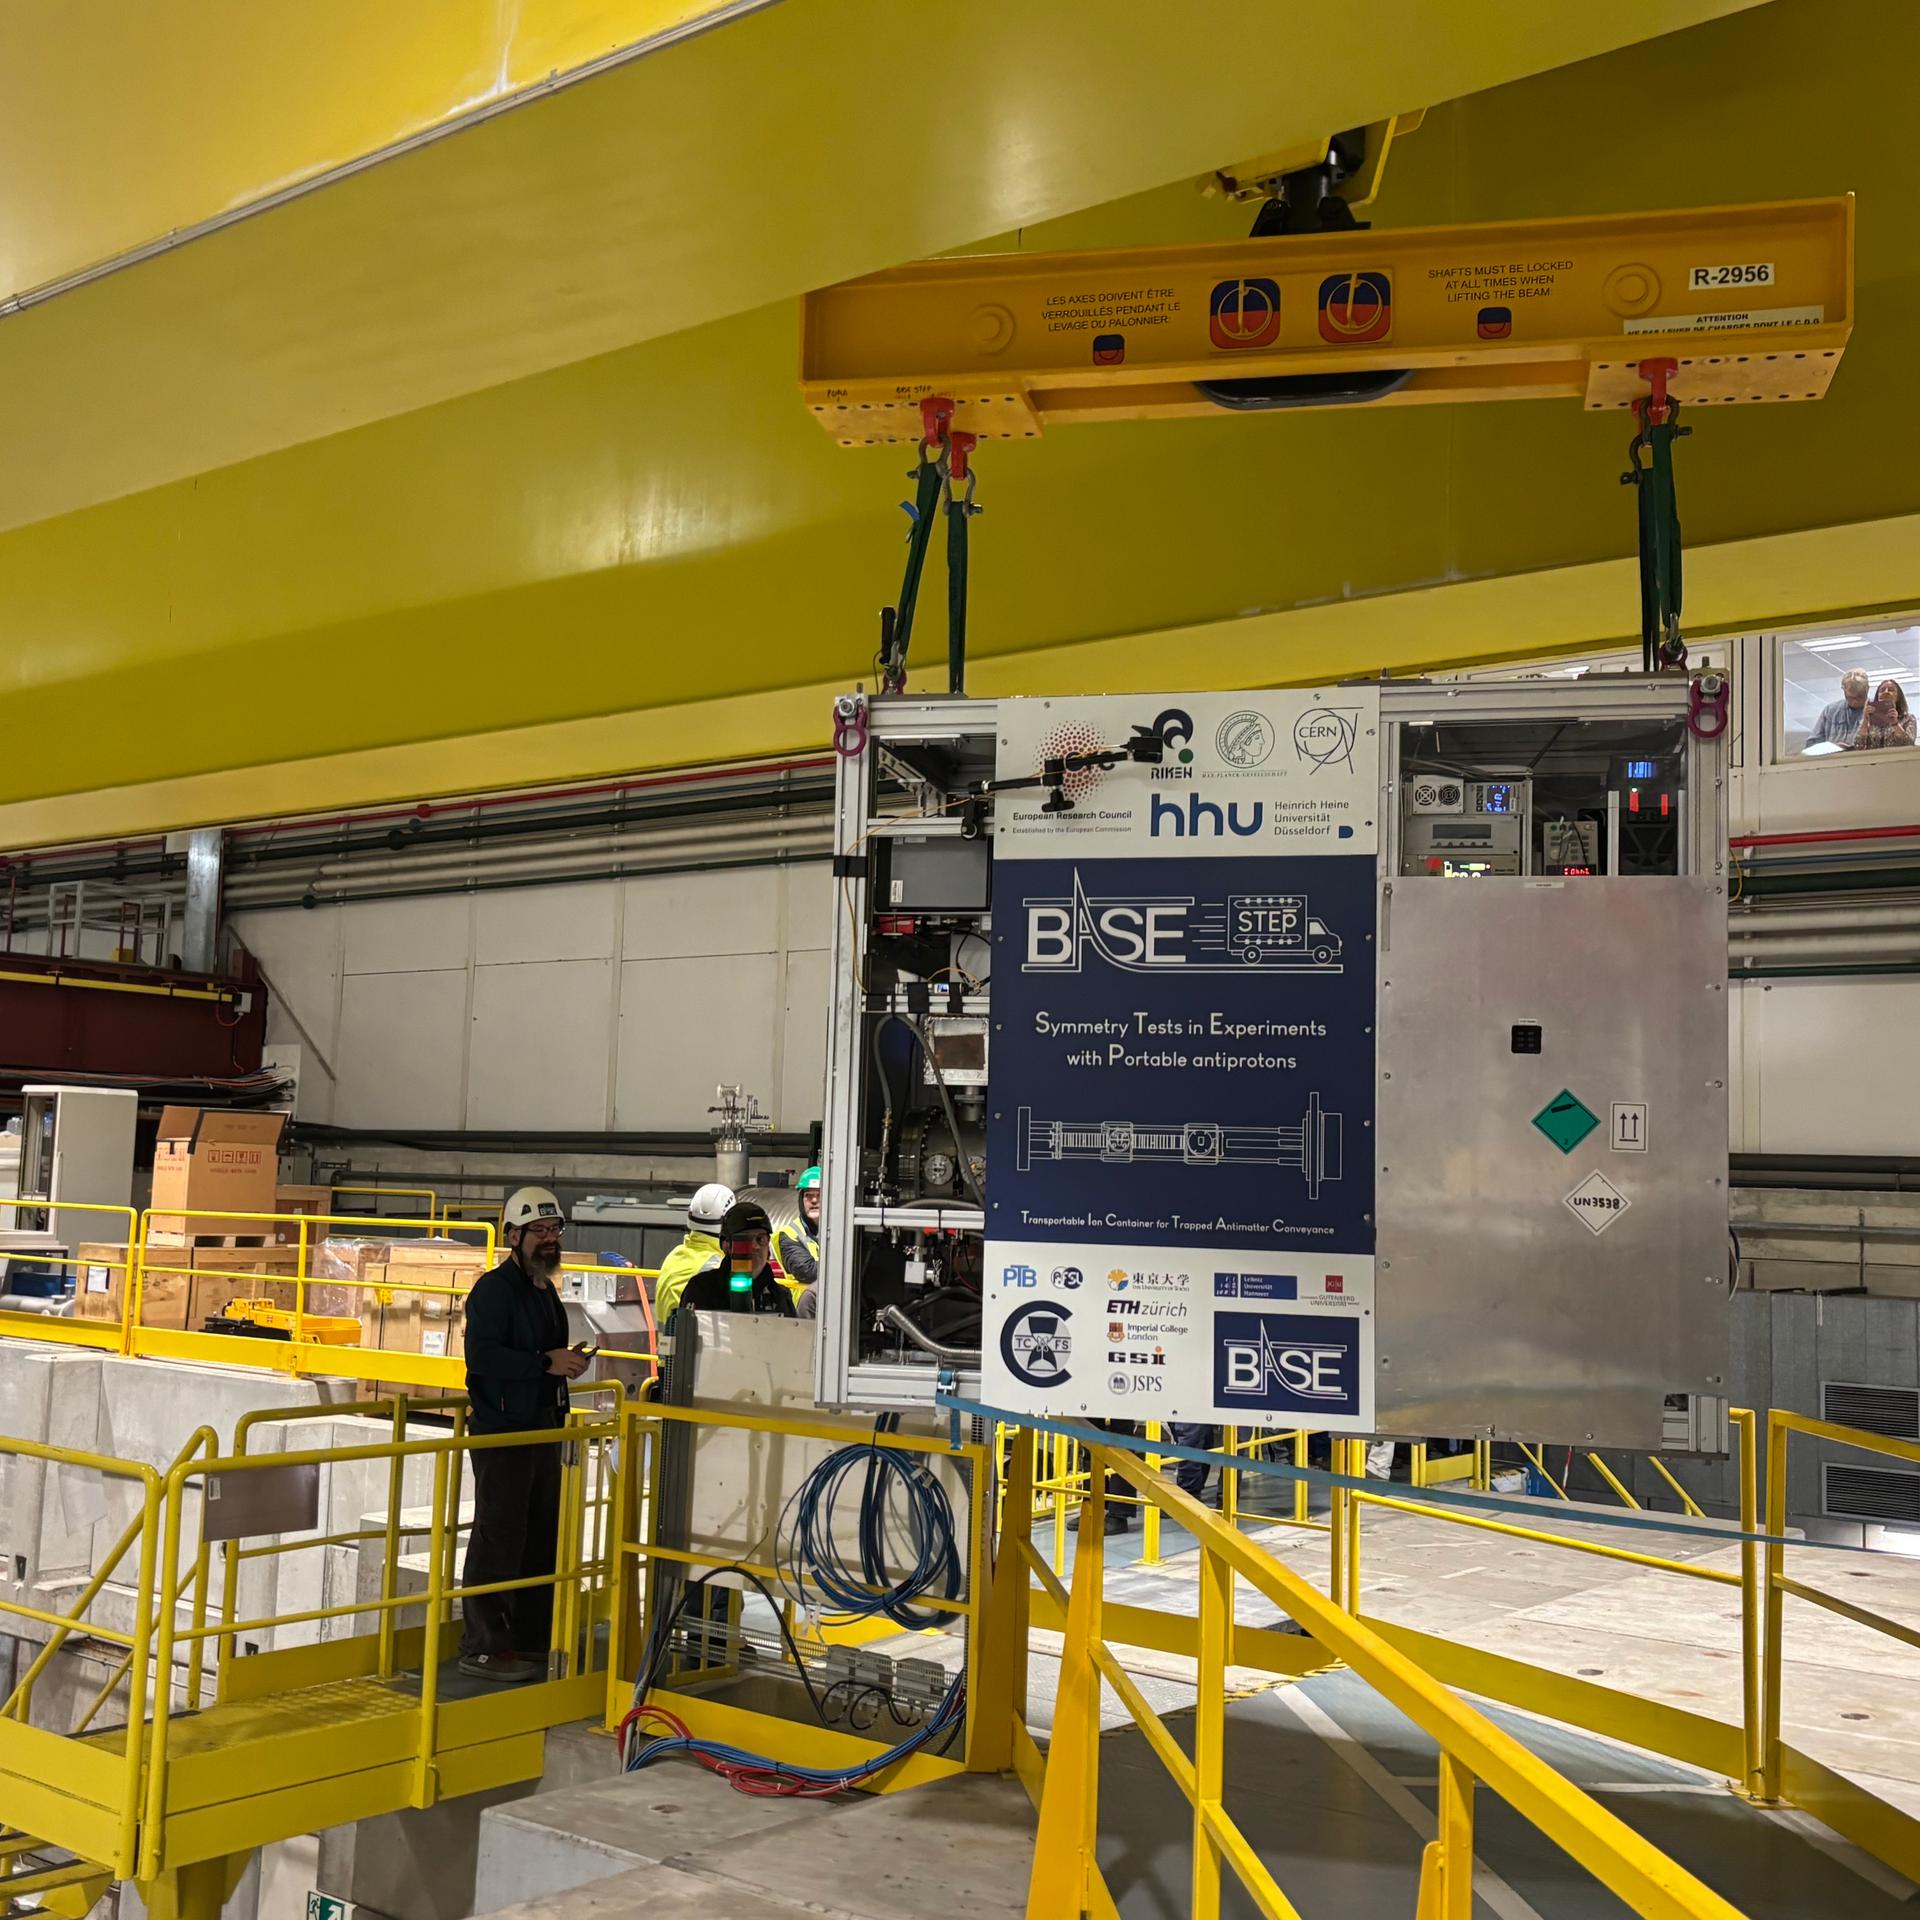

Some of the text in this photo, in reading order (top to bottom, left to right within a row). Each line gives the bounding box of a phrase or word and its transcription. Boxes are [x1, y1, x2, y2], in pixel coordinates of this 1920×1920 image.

[1428, 260, 1574, 279] SHAFTS MUST BE LOCKED
[1694, 265, 1769, 285] R-2956
[1445, 275, 1554, 290] AT ALL TIMES WHEN
[1046, 296, 1066, 306] LES
[1069, 294, 1096, 304] AXES
[1098, 291, 1144, 302] DOIVENT
[1447, 288, 1550, 303] LIFTING THE BEAM
[1116, 303, 1165, 315] PENDANT
[1168, 302, 1181, 311] LE
[1048, 315, 1168, 332] LEVAGE DU PALONNIER
[1696, 313, 1749, 323] ATTENTION
[1299, 726, 1337, 738] CERN
[1151, 766, 1193, 780] RIKEN
[1274, 800, 1349, 810] Heinrich Heine
[1013, 811, 1132, 821] European Research Council
[1150, 793, 1263, 837] hhu
[1274, 814, 1330, 823] Universität
[1274, 825, 1330, 836] Düsseldorf
[1028, 867, 1187, 973] BASE
[1035, 1011, 1327, 1039] Symmetry Tests in Experiments
[1067, 1044, 1297, 1071] with Portable antiprotons
[1021, 1210, 1335, 1235] Transportable Ion Container for Trapped Antimatter Conveyance
[1003, 1265, 1037, 1288] PTB
[1133, 1272, 1190, 1286] 東京大学
[1127, 1323, 1189, 1336] Imperial College
[1127, 1332, 1158, 1341] London
[1228, 1319, 1342, 1395] BASE
[1130, 1375, 1163, 1393] JSPS
